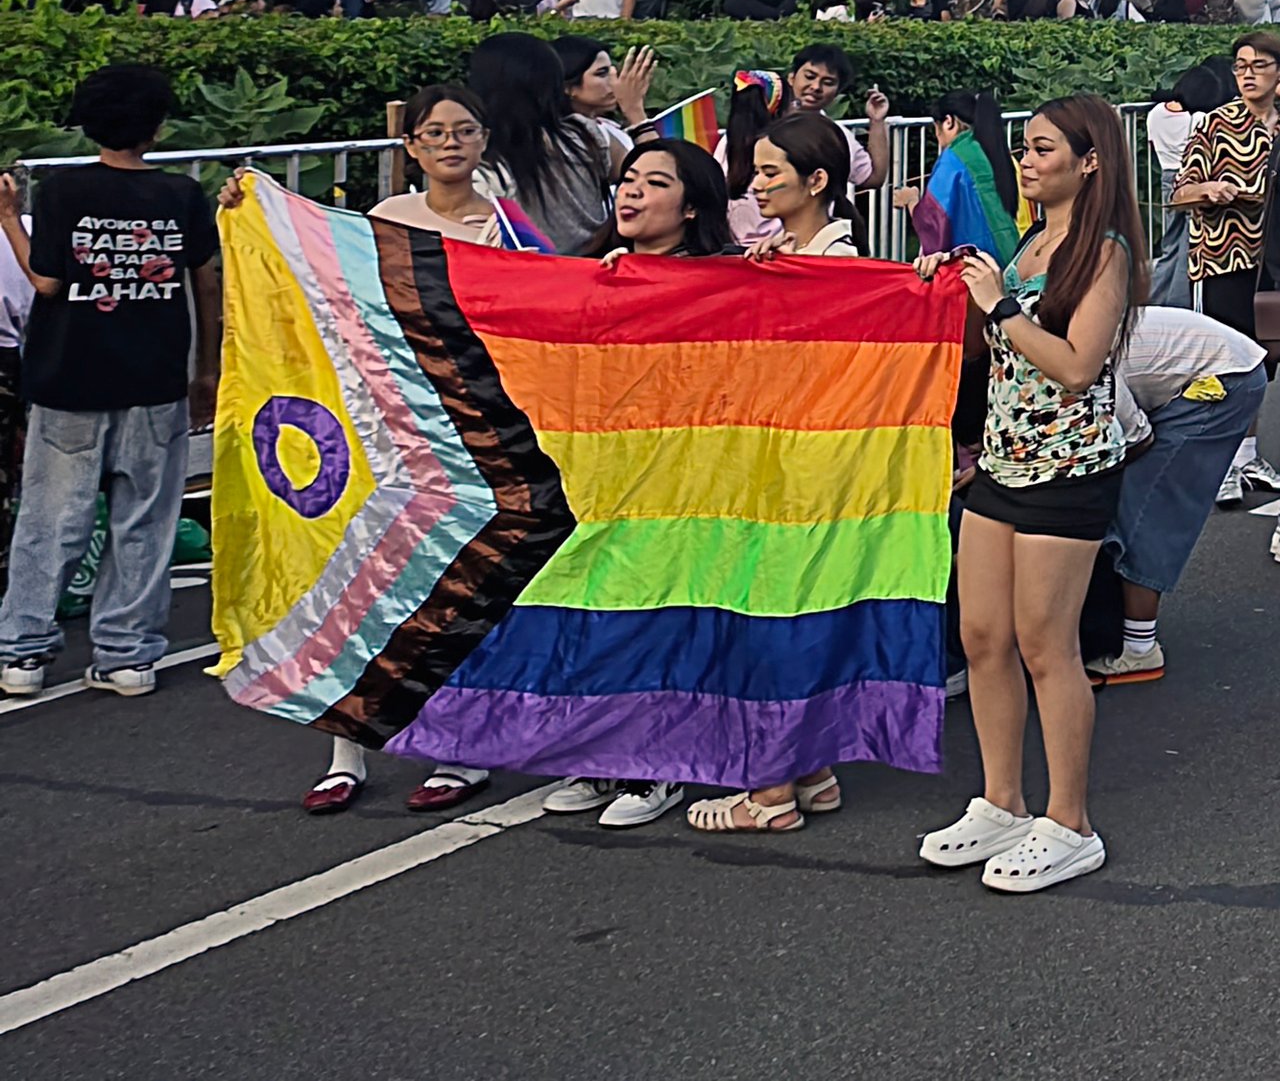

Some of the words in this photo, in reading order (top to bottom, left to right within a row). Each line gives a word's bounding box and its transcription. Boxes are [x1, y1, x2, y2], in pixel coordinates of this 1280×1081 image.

[77, 216, 148, 230] AYOKO
[151, 219, 179, 231] SA
[72, 231, 184, 251] BABAE
[114, 254, 168, 265] PAR
[110, 268, 139, 279] SA
[68, 283, 181, 301] LAHAT
